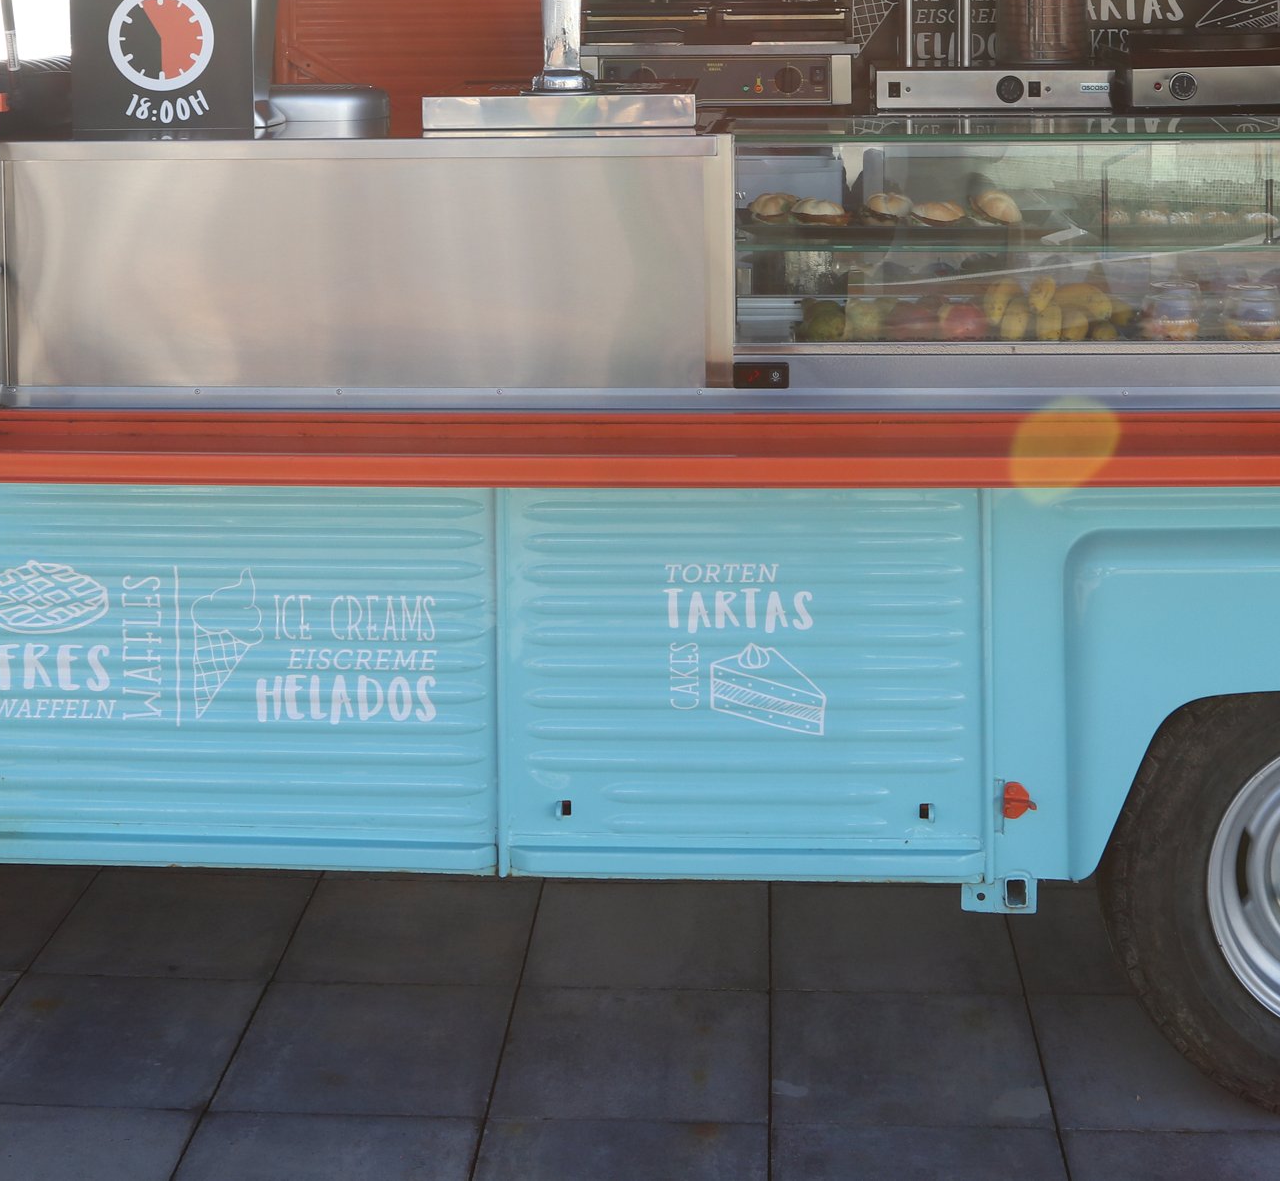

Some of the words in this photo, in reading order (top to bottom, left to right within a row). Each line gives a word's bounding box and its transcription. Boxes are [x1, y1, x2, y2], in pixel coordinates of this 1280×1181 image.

[125, 89, 210, 125] 18:00H
[1081, 84, 1109, 92] ascaso
[664, 563, 780, 584] TORTEN
[273, 593, 313, 641] ICE
[329, 593, 437, 643] CREAMS
[663, 587, 814, 634] TARTAS
[121, 574, 163, 721] WAFFLES
[288, 648, 438, 672] EISCREME
[256, 674, 437, 726] HELADOS
[669, 642, 700, 711] CAKES
